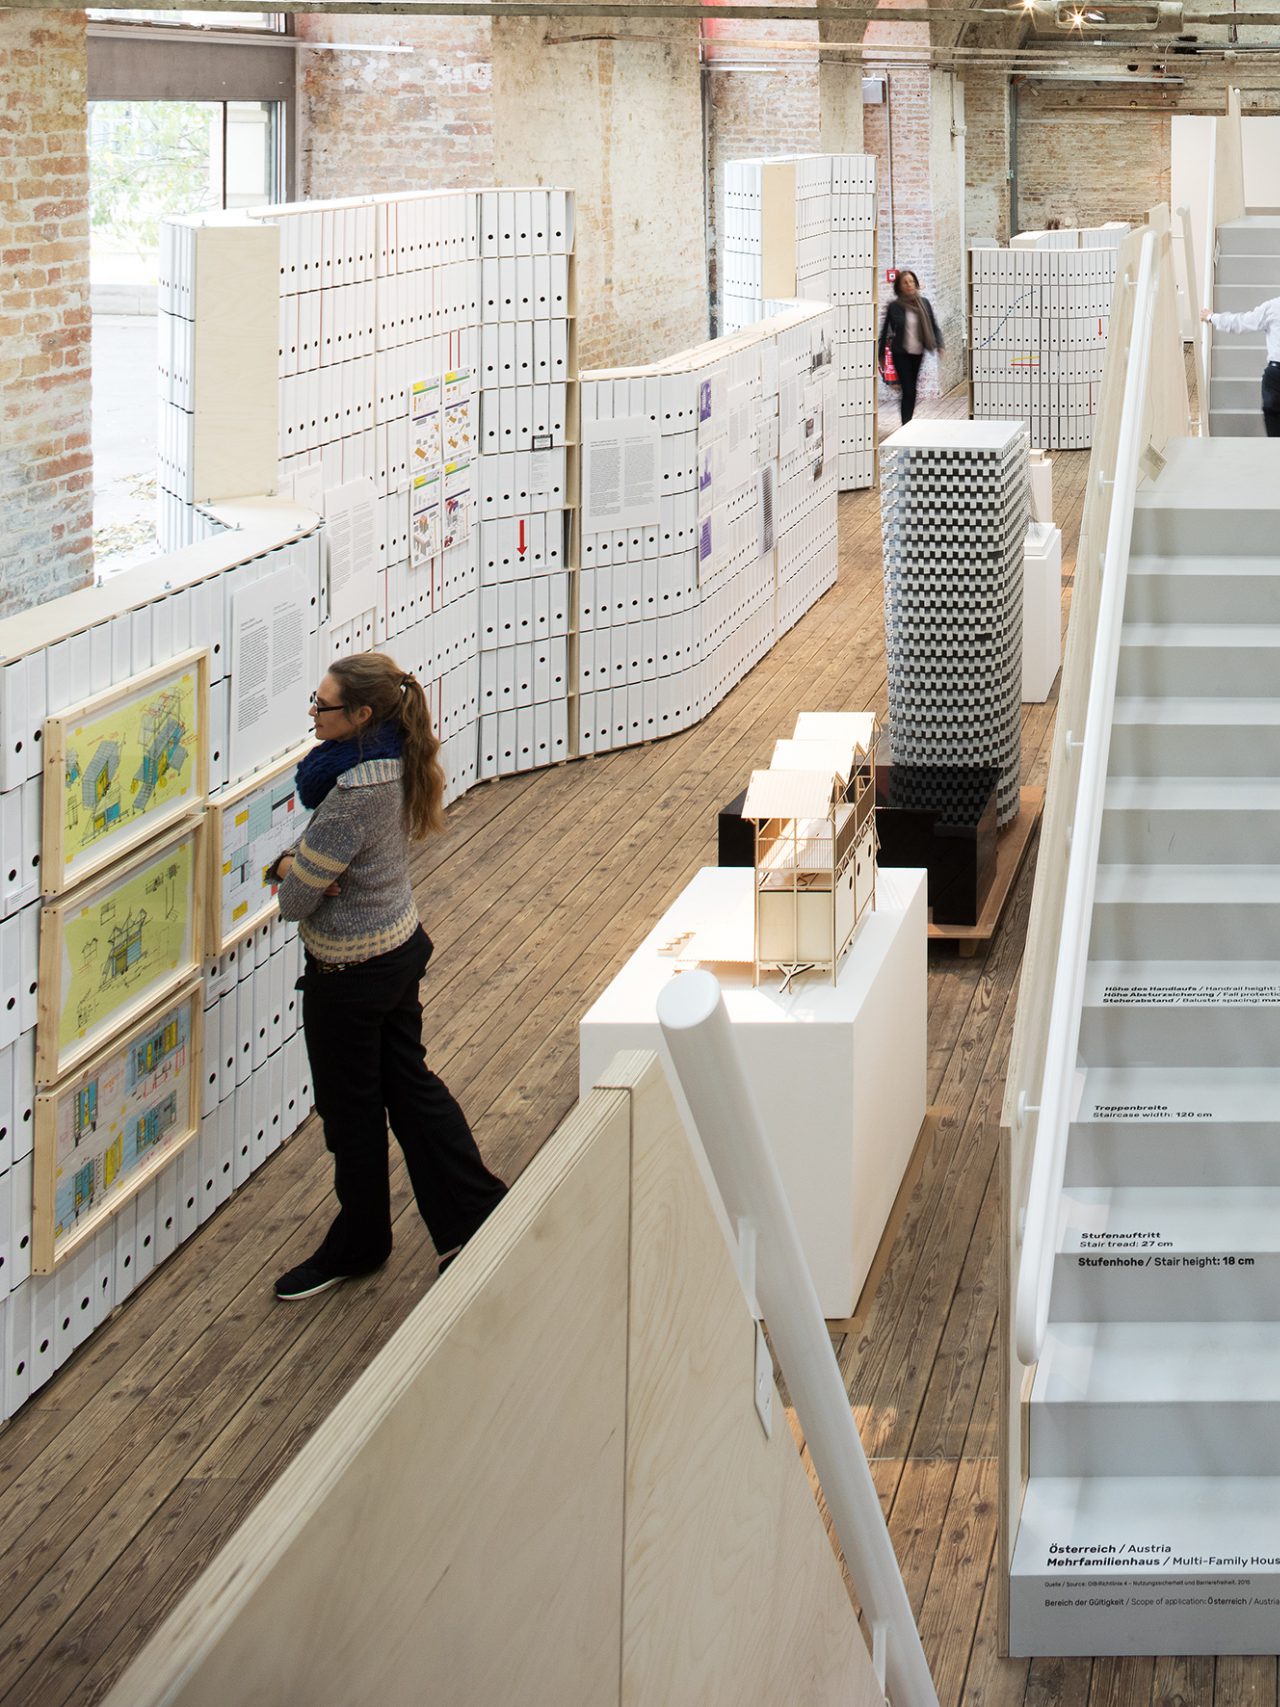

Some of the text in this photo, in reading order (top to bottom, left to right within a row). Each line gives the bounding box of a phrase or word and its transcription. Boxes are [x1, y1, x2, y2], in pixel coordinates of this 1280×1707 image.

[1245, 985, 1277, 993] height:
[1222, 997, 1261, 1005] spacing:
[1095, 1105, 1168, 1113] Treppenbreite
[1082, 1232, 1161, 1240] Stufenauftritt
[1080, 1240, 1106, 1248] Stair
[1107, 1240, 1139, 1248] tread:
[1145, 1257, 1153, 1267] /
[1154, 1257, 1181, 1266] Stair
[1182, 1257, 1221, 1269] height:
[1222, 1257, 1236, 1266] 18
[1237, 1258, 1255, 1266] cm
[1049, 1543, 1172, 1554] Österreich / Austria
[1047, 1556, 1160, 1567] Mehrfamilienhaus
[1162, 1556, 1171, 1567] /
[1172, 1556, 1249, 1569] Multi-Family
[1045, 1599, 1074, 1607] Bereich
[1074, 1599, 1088, 1607] der
[1088, 1598, 1125, 1608] Gültigkeit
[1131, 1598, 1155, 1608] Scope
[1156, 1597, 1164, 1606] of
[1164, 1597, 1207, 1608] application:
[1207, 1597, 1248, 1607] Österreich
[1253, 1597, 1280, 1606] Austria
